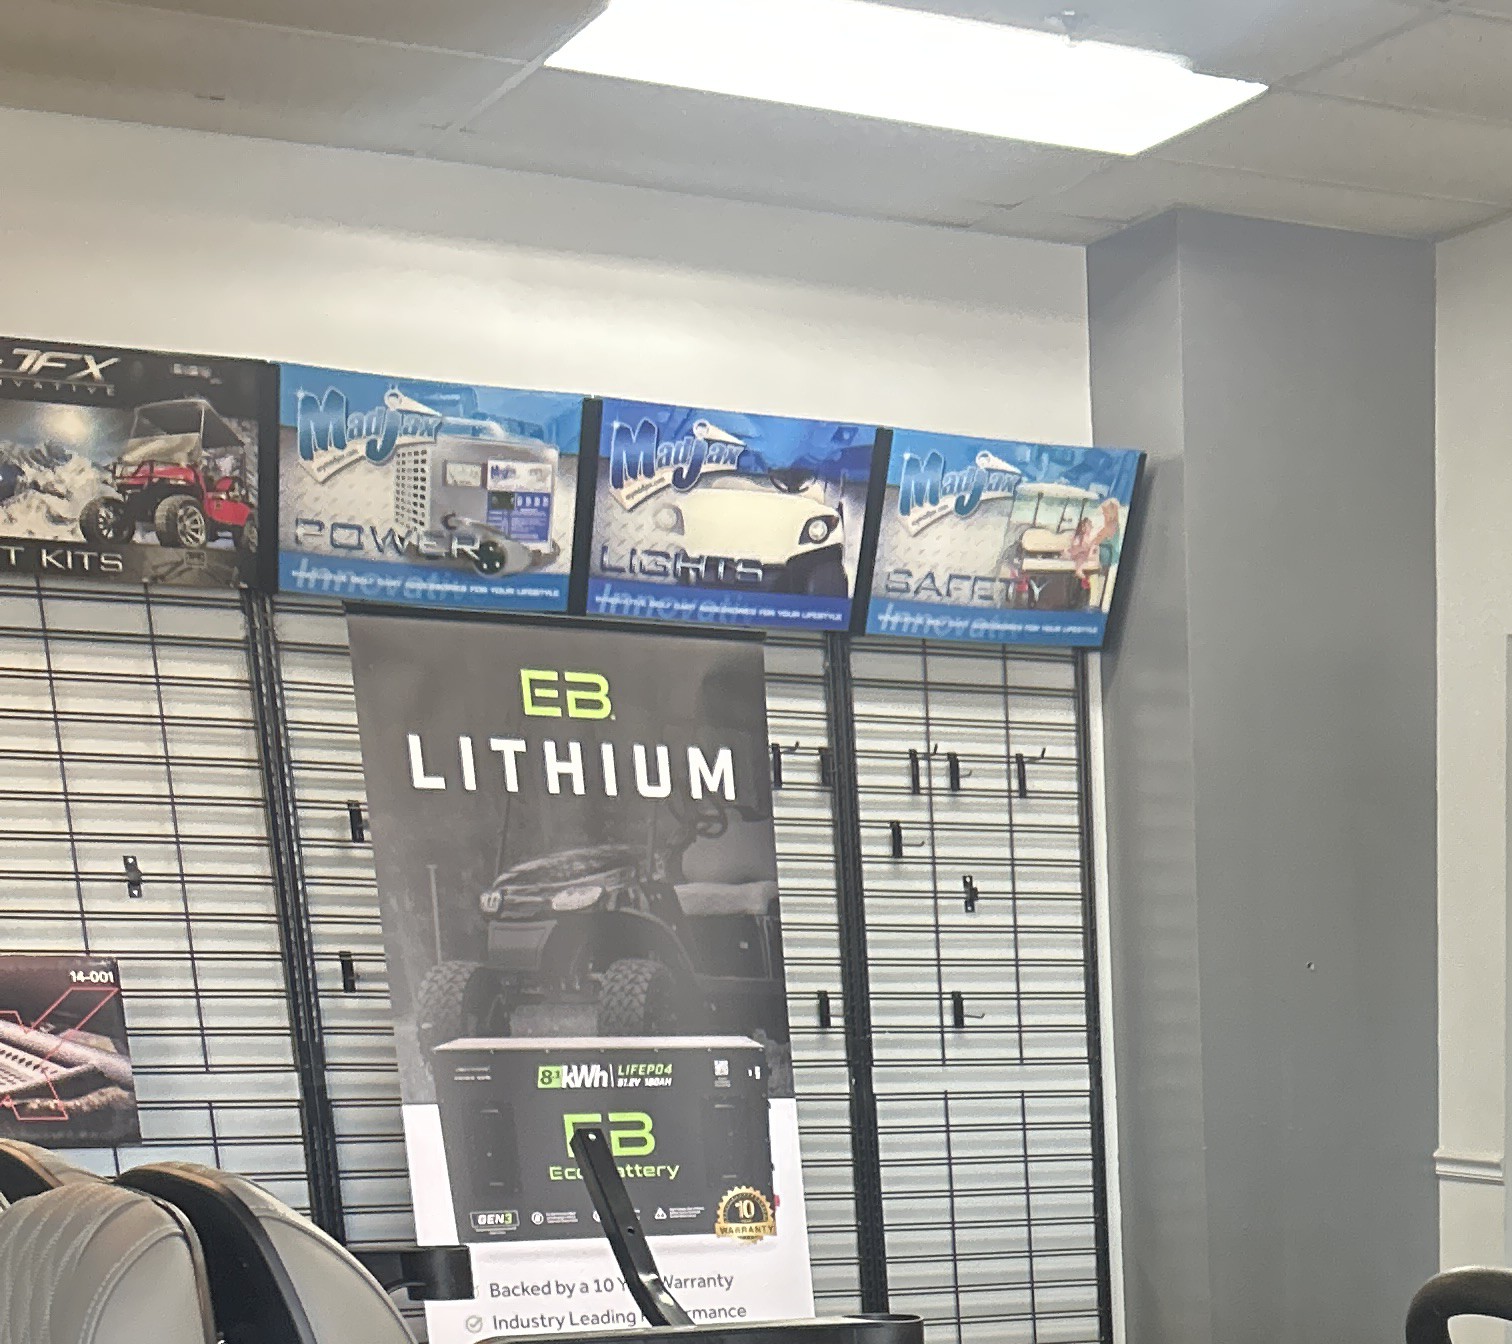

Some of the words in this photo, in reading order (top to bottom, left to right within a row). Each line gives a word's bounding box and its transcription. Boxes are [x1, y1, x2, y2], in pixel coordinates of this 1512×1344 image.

[0, 348, 121, 381] JFX
[0, 379, 115, 396] VATIVE
[296, 517, 481, 561] POWER
[41, 538, 123, 573] KITS
[601, 544, 763, 584] LIGHTS
[886, 567, 1049, 604] SAFETY
[520, 668, 612, 718] EB
[408, 733, 736, 800] LITHIUM
[69, 970, 114, 983] 14-001
[549, 1163, 679, 1180] Ecattery
[478, 1212, 512, 1225] GEN3
[734, 1199, 754, 1219] 10
[720, 1225, 774, 1235] WARRANTY
[490, 1280, 551, 1298] Backed
[555, 1279, 575, 1298] by
[579, 1282, 589, 1294] a
[594, 1278, 614, 1293] 10
[493, 1313, 565, 1331] Industry
[569, 1309, 636, 1328] Leading
